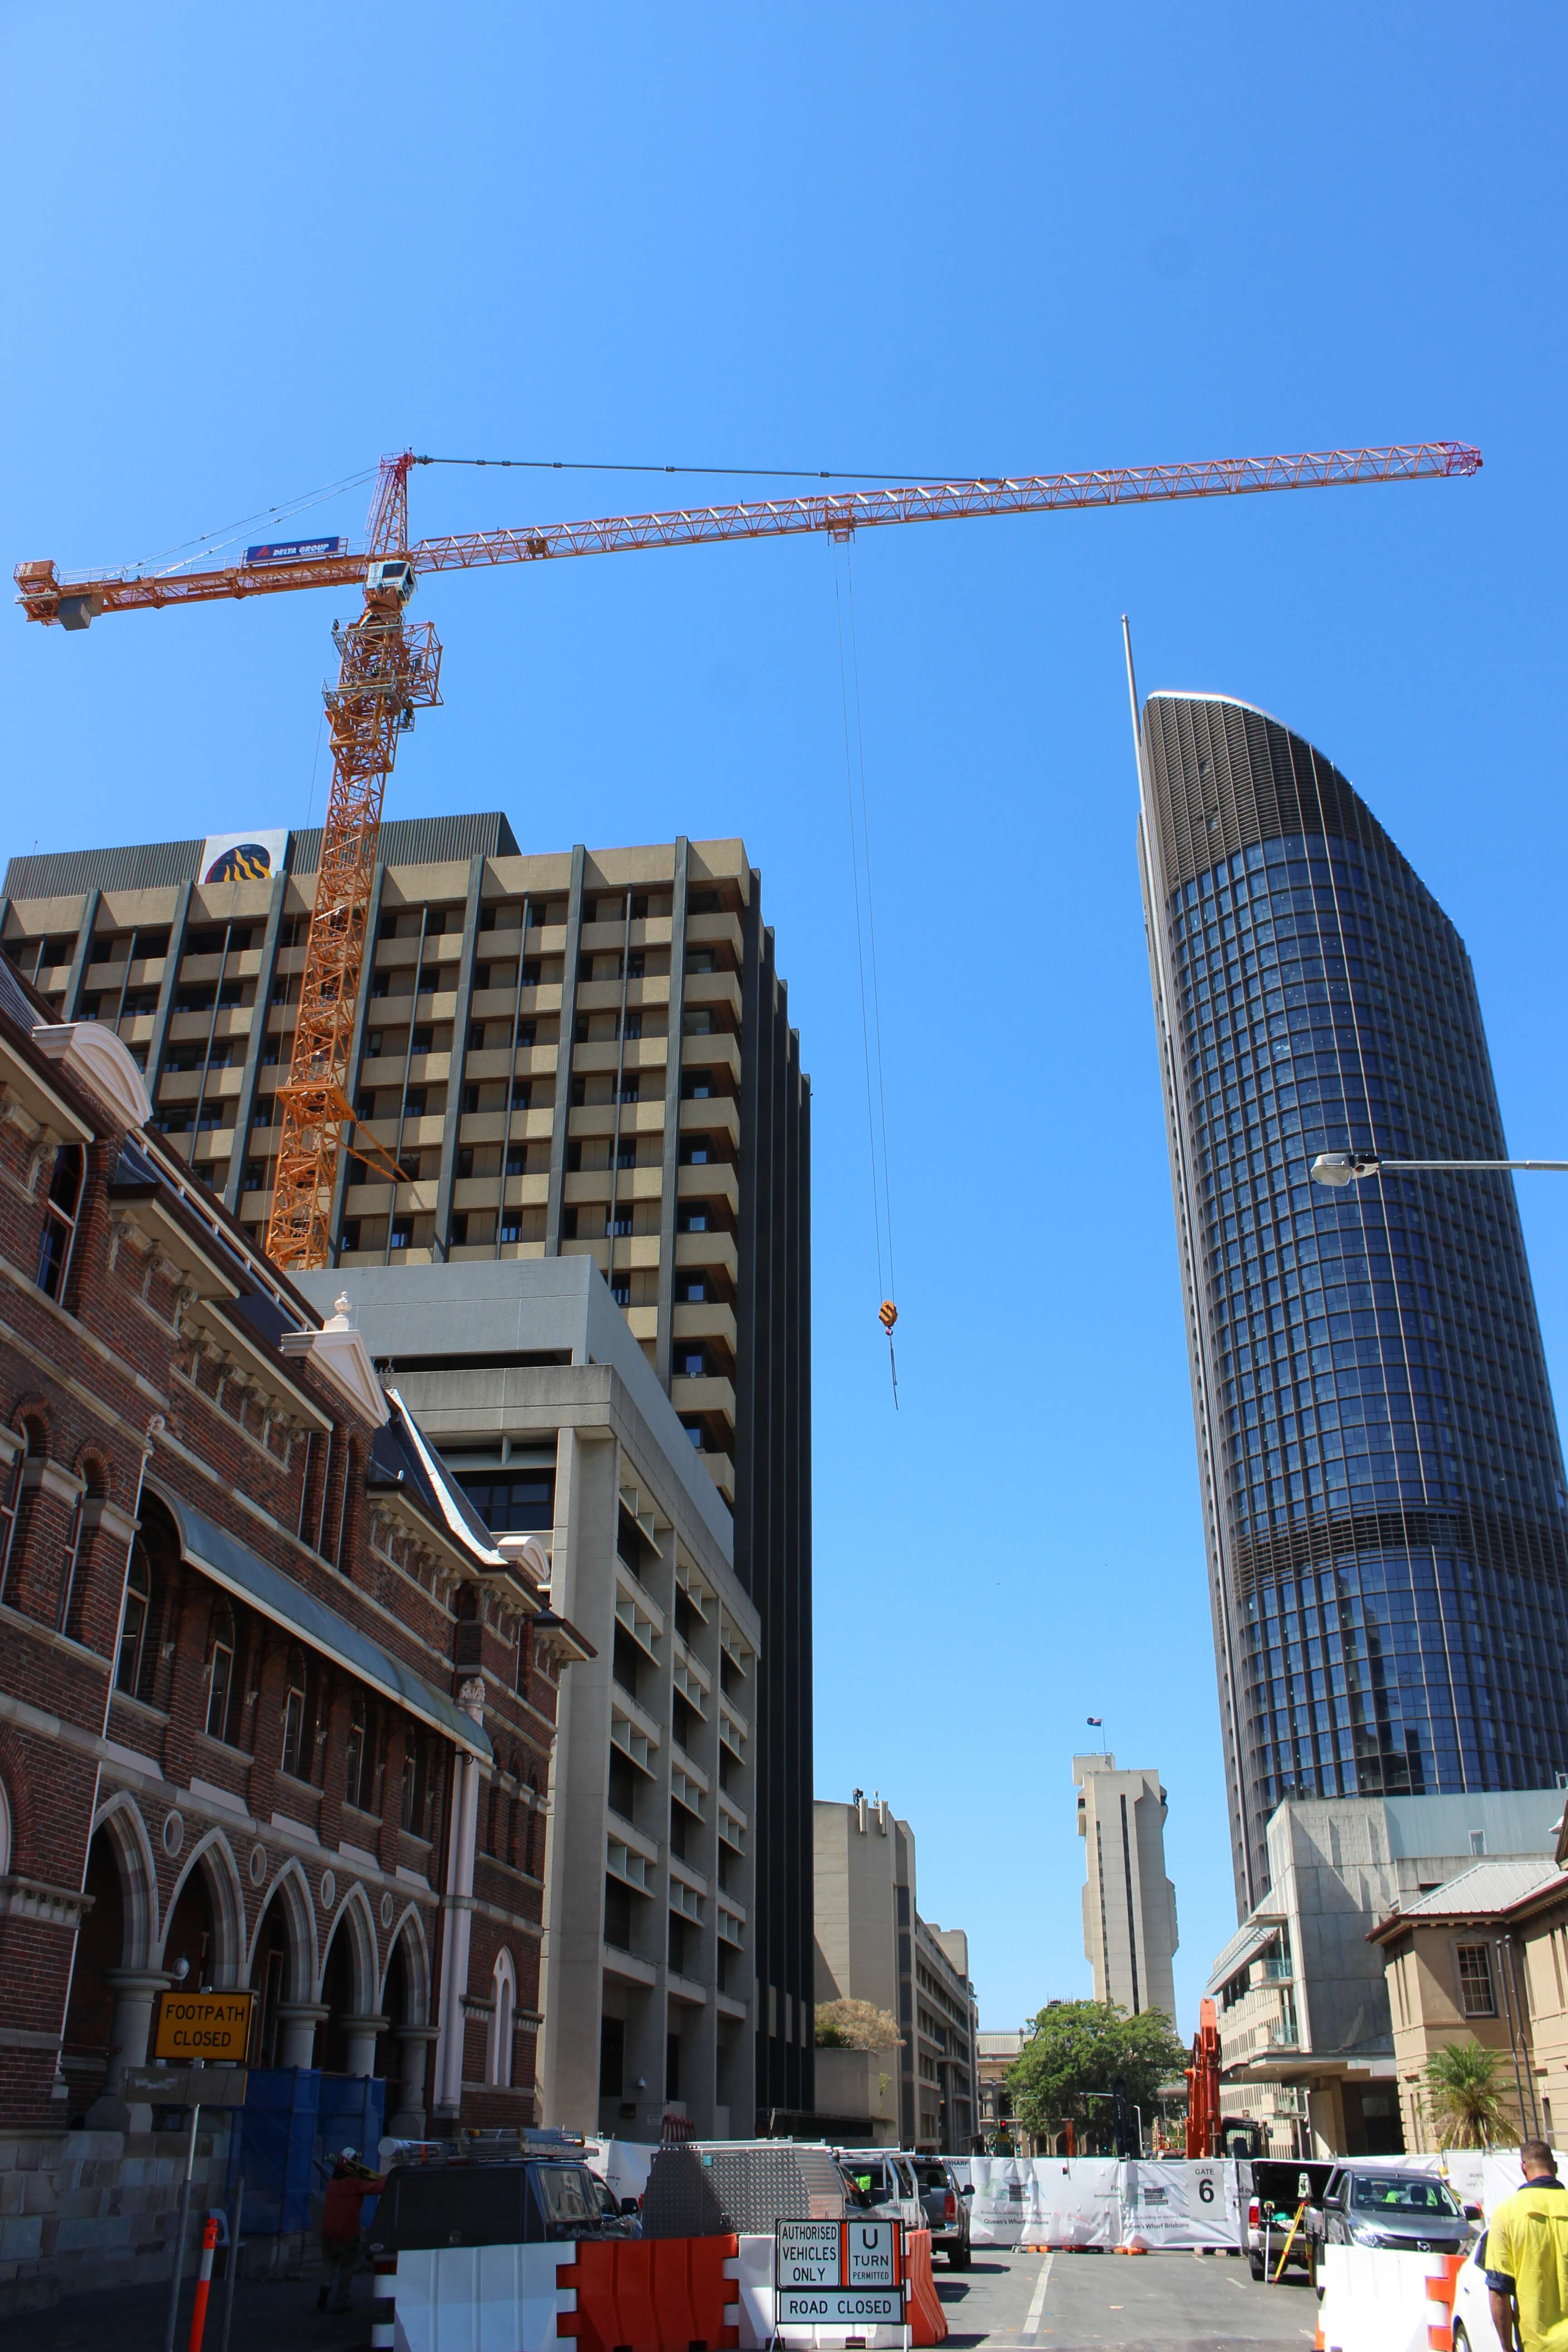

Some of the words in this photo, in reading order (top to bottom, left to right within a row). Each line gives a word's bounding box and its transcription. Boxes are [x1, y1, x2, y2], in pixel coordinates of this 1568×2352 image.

[273, 548, 297, 556] DELTA
[299, 544, 329, 553] GROUP
[166, 2004, 245, 2021] FOOTPATH
[173, 2030, 231, 2047] CLOSED
[1199, 2179, 1214, 2203] 6
[782, 2226, 837, 2240] AUTHORISED
[862, 2229, 878, 2249] U
[782, 2247, 836, 2260] VEHICLES
[853, 2255, 889, 2266] TURN
[793, 2268, 826, 2281] ONLY
[853, 2272, 889, 2280] PERMITTED
[790, 2300, 828, 2314] ROAD
[838, 2300, 892, 2314] CLOSED
